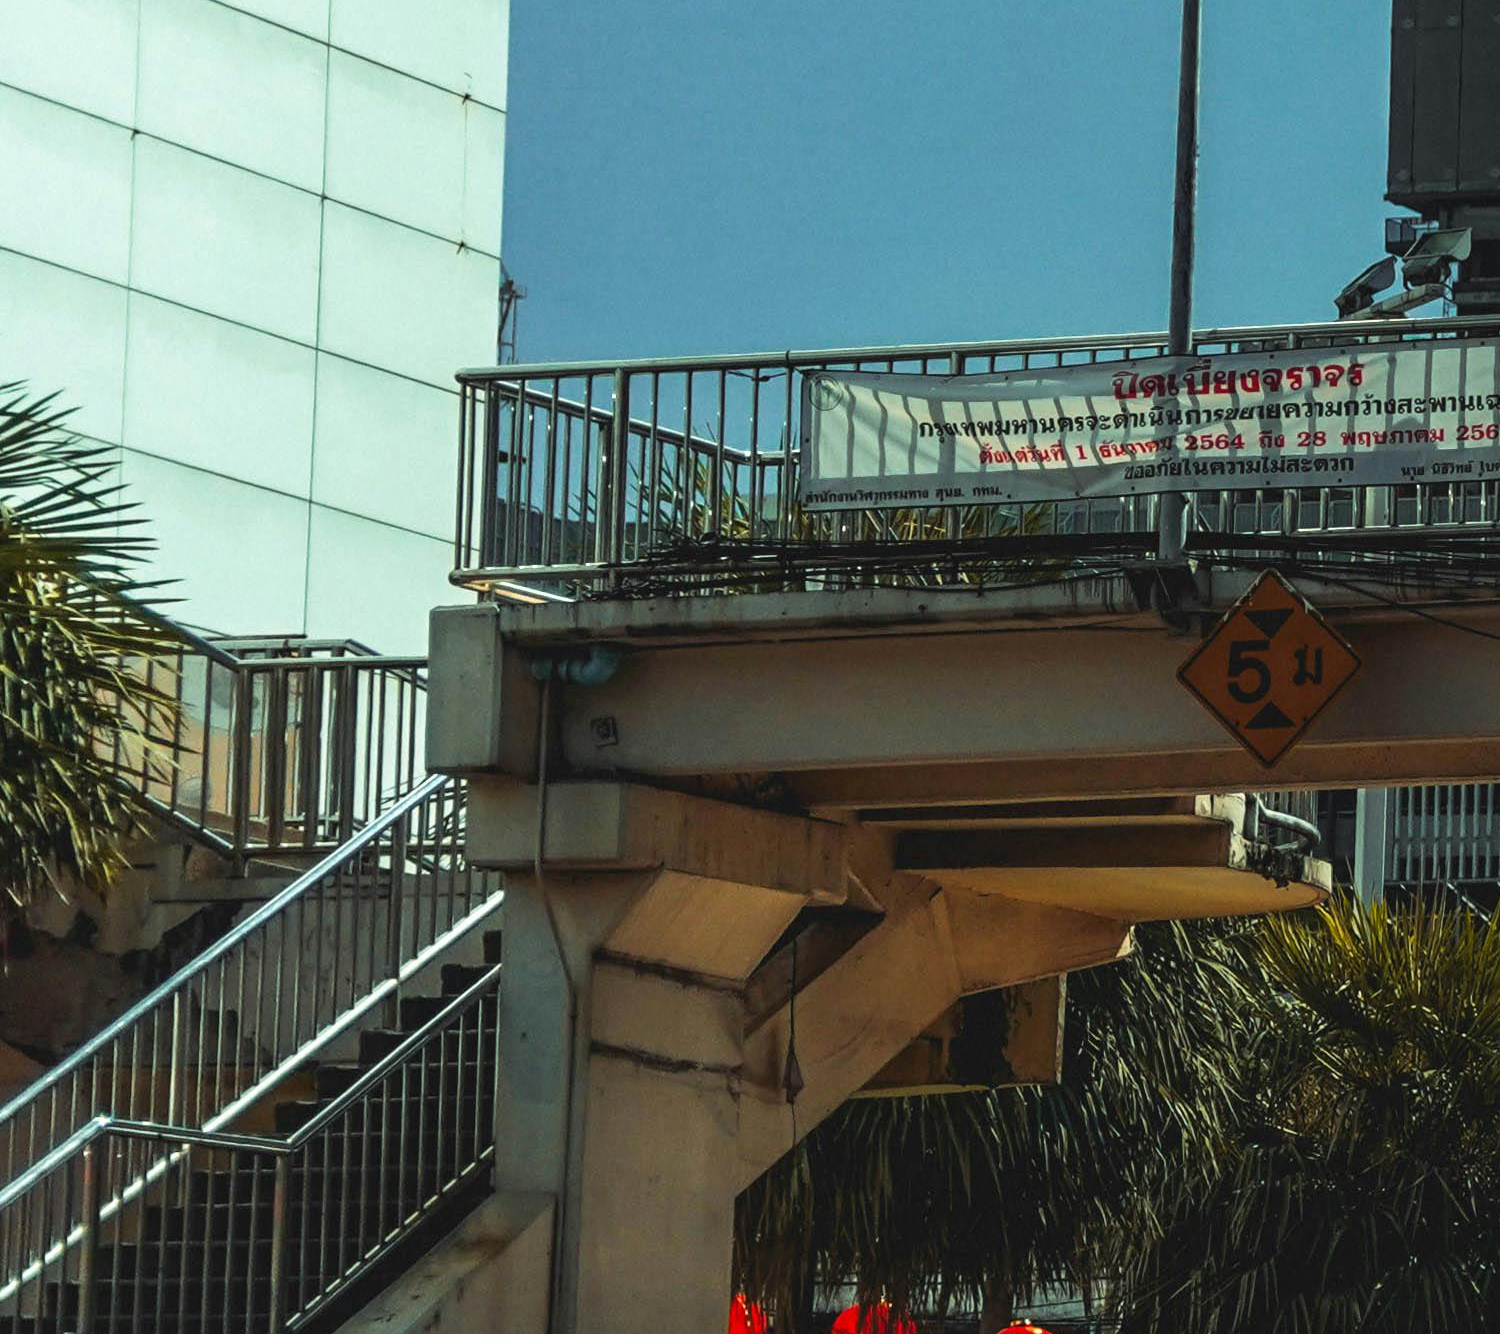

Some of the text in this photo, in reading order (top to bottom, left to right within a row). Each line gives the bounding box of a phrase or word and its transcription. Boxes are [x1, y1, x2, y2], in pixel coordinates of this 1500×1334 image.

[1111, 358, 1365, 399] ปิดเบี่ยงจราจร
[1076, 444, 1088, 461] 1
[1184, 432, 1246, 451] 2564
[1259, 428, 1286, 449] ถึง
[1296, 431, 1327, 448] 28
[1341, 425, 1445, 448] พฤษภาคม
[1124, 455, 1356, 480] ขออภัยในความไม่สะดวก
[1228, 639, 1323, 704] 5 ม
